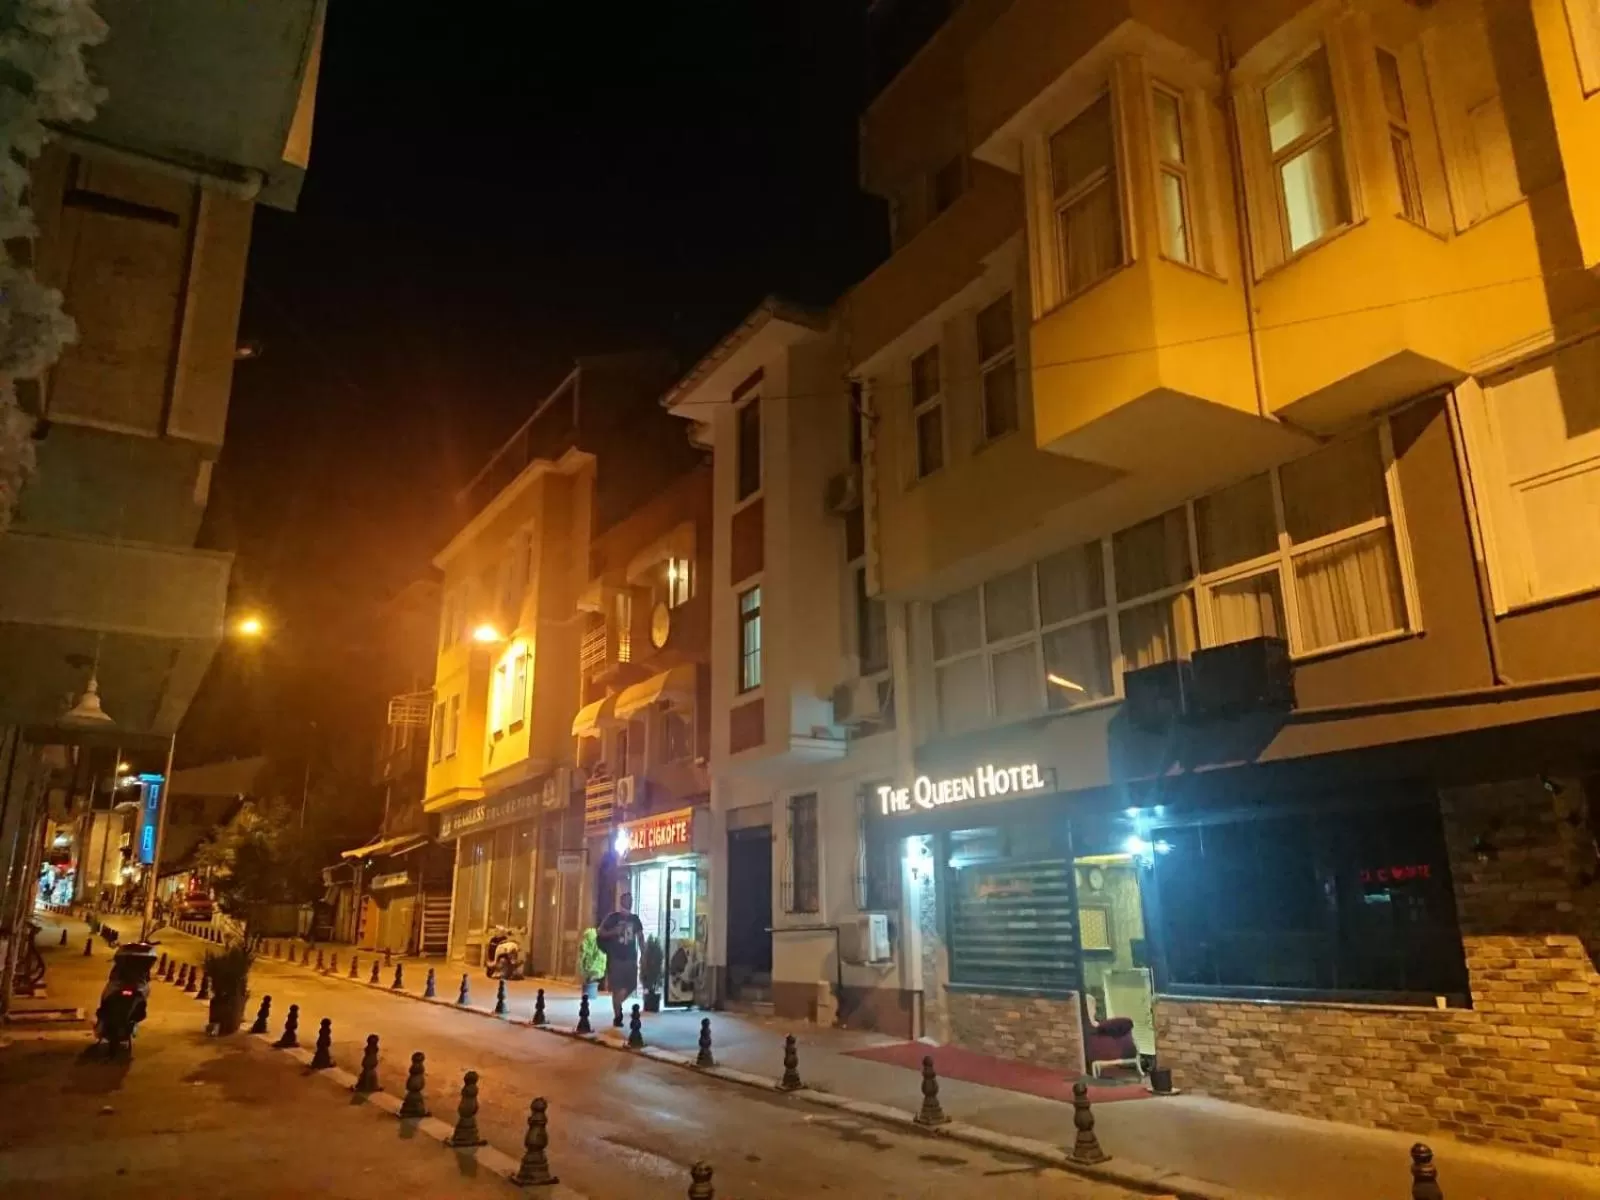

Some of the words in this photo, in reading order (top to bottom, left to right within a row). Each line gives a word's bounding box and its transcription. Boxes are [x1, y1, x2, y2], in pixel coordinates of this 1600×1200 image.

[877, 785, 911, 816] THE
[913, 775, 976, 809] QUEEN
[976, 763, 1045, 798] HOTEL
